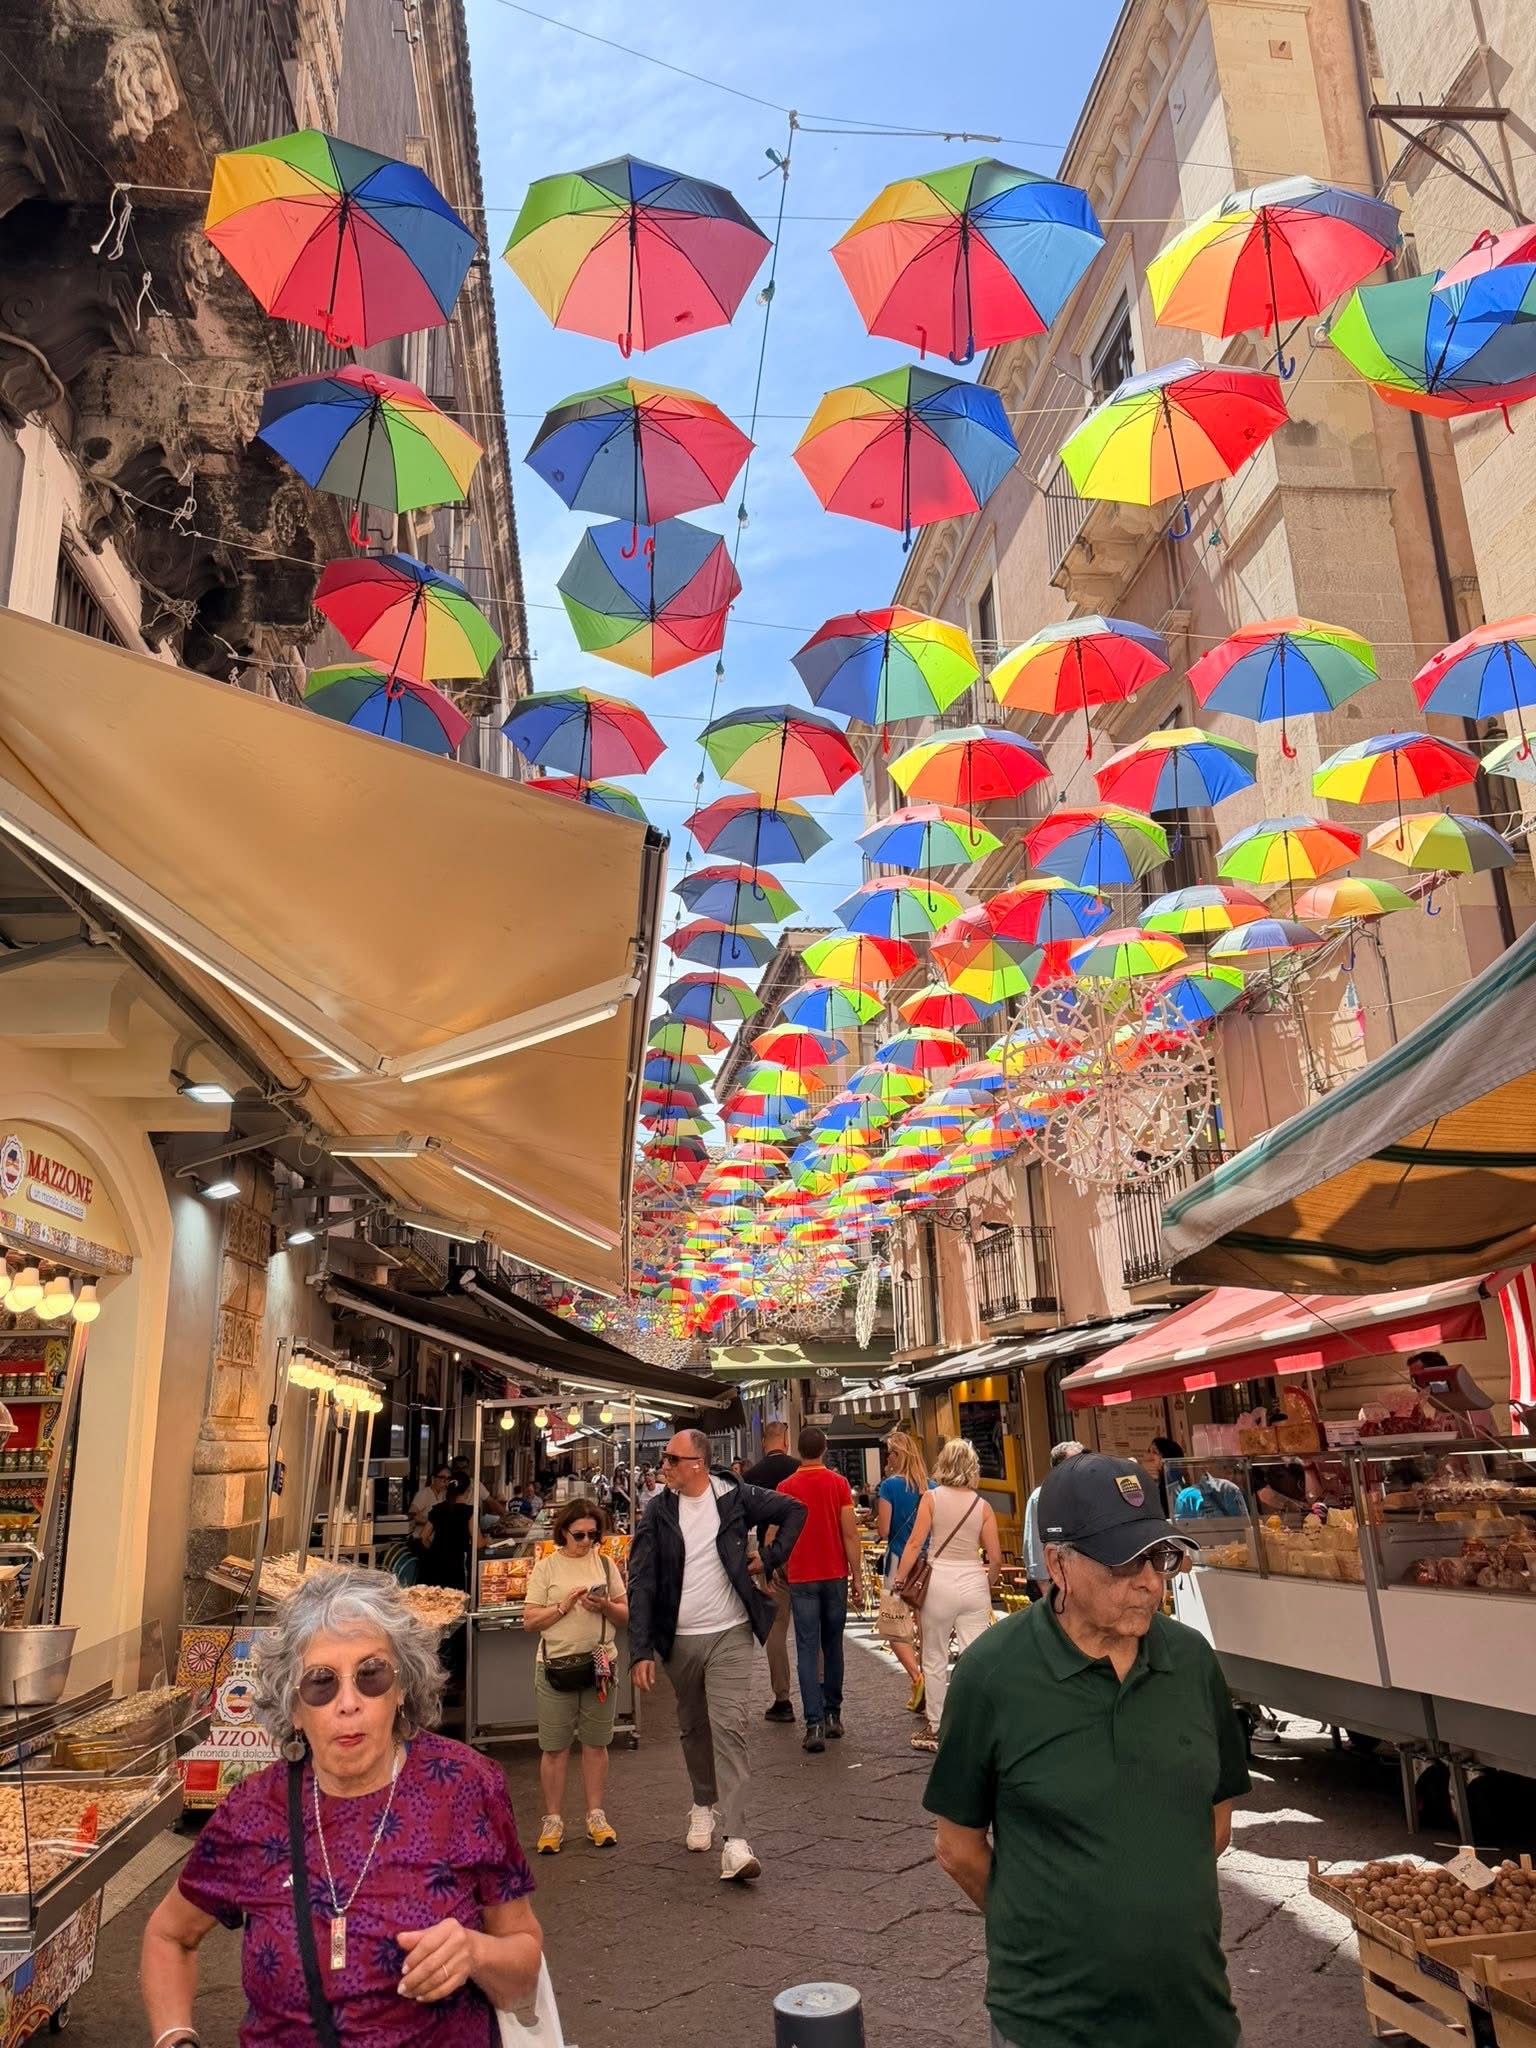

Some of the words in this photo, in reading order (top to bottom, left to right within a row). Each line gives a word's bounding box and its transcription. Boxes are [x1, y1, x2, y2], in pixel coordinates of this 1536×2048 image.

[27, 1149, 94, 1204] MAZZONE
[203, 1730, 270, 1746] AZZON
[196, 1748, 230, 1758] mondo
[232, 1748, 240, 1758] di
